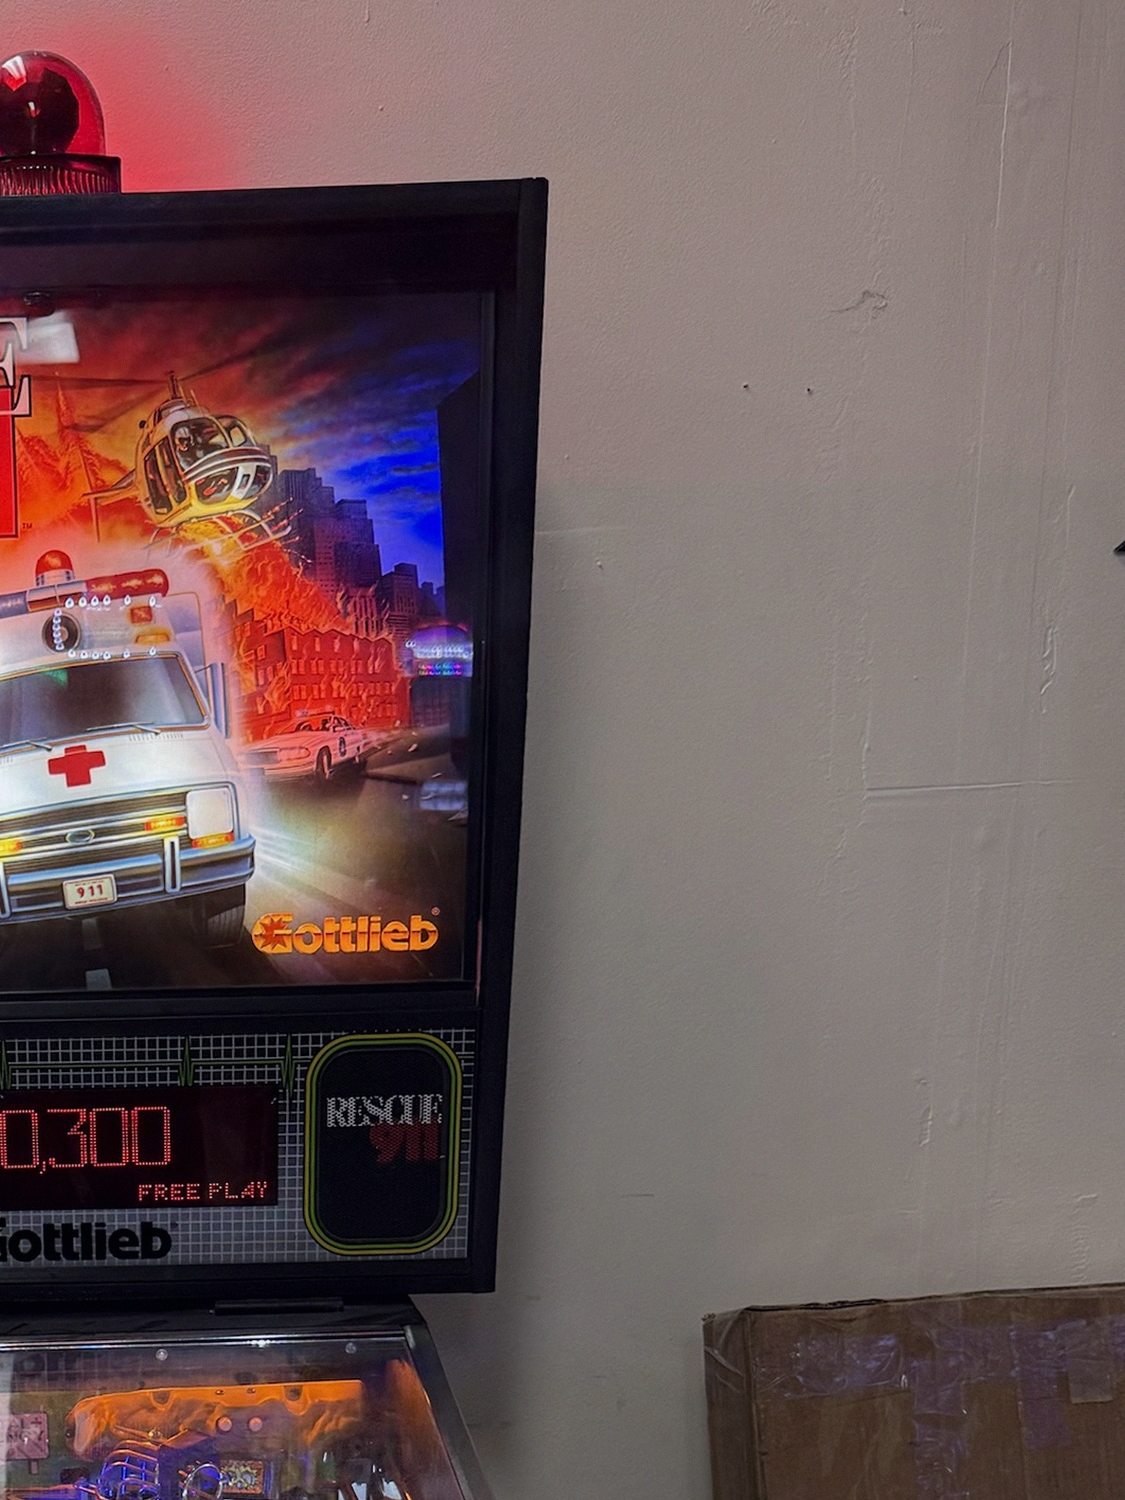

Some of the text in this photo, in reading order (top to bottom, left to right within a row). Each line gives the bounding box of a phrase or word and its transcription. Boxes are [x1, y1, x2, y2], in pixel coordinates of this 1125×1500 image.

[76, 883, 104, 899] 911
[251, 912, 439, 955] Gottlieb
[327, 1094, 443, 1128] RESCUE
[369, 1122, 439, 1164] 911
[137, 1182, 201, 1202] FREE
[208, 1180, 269, 1200] PLAY
